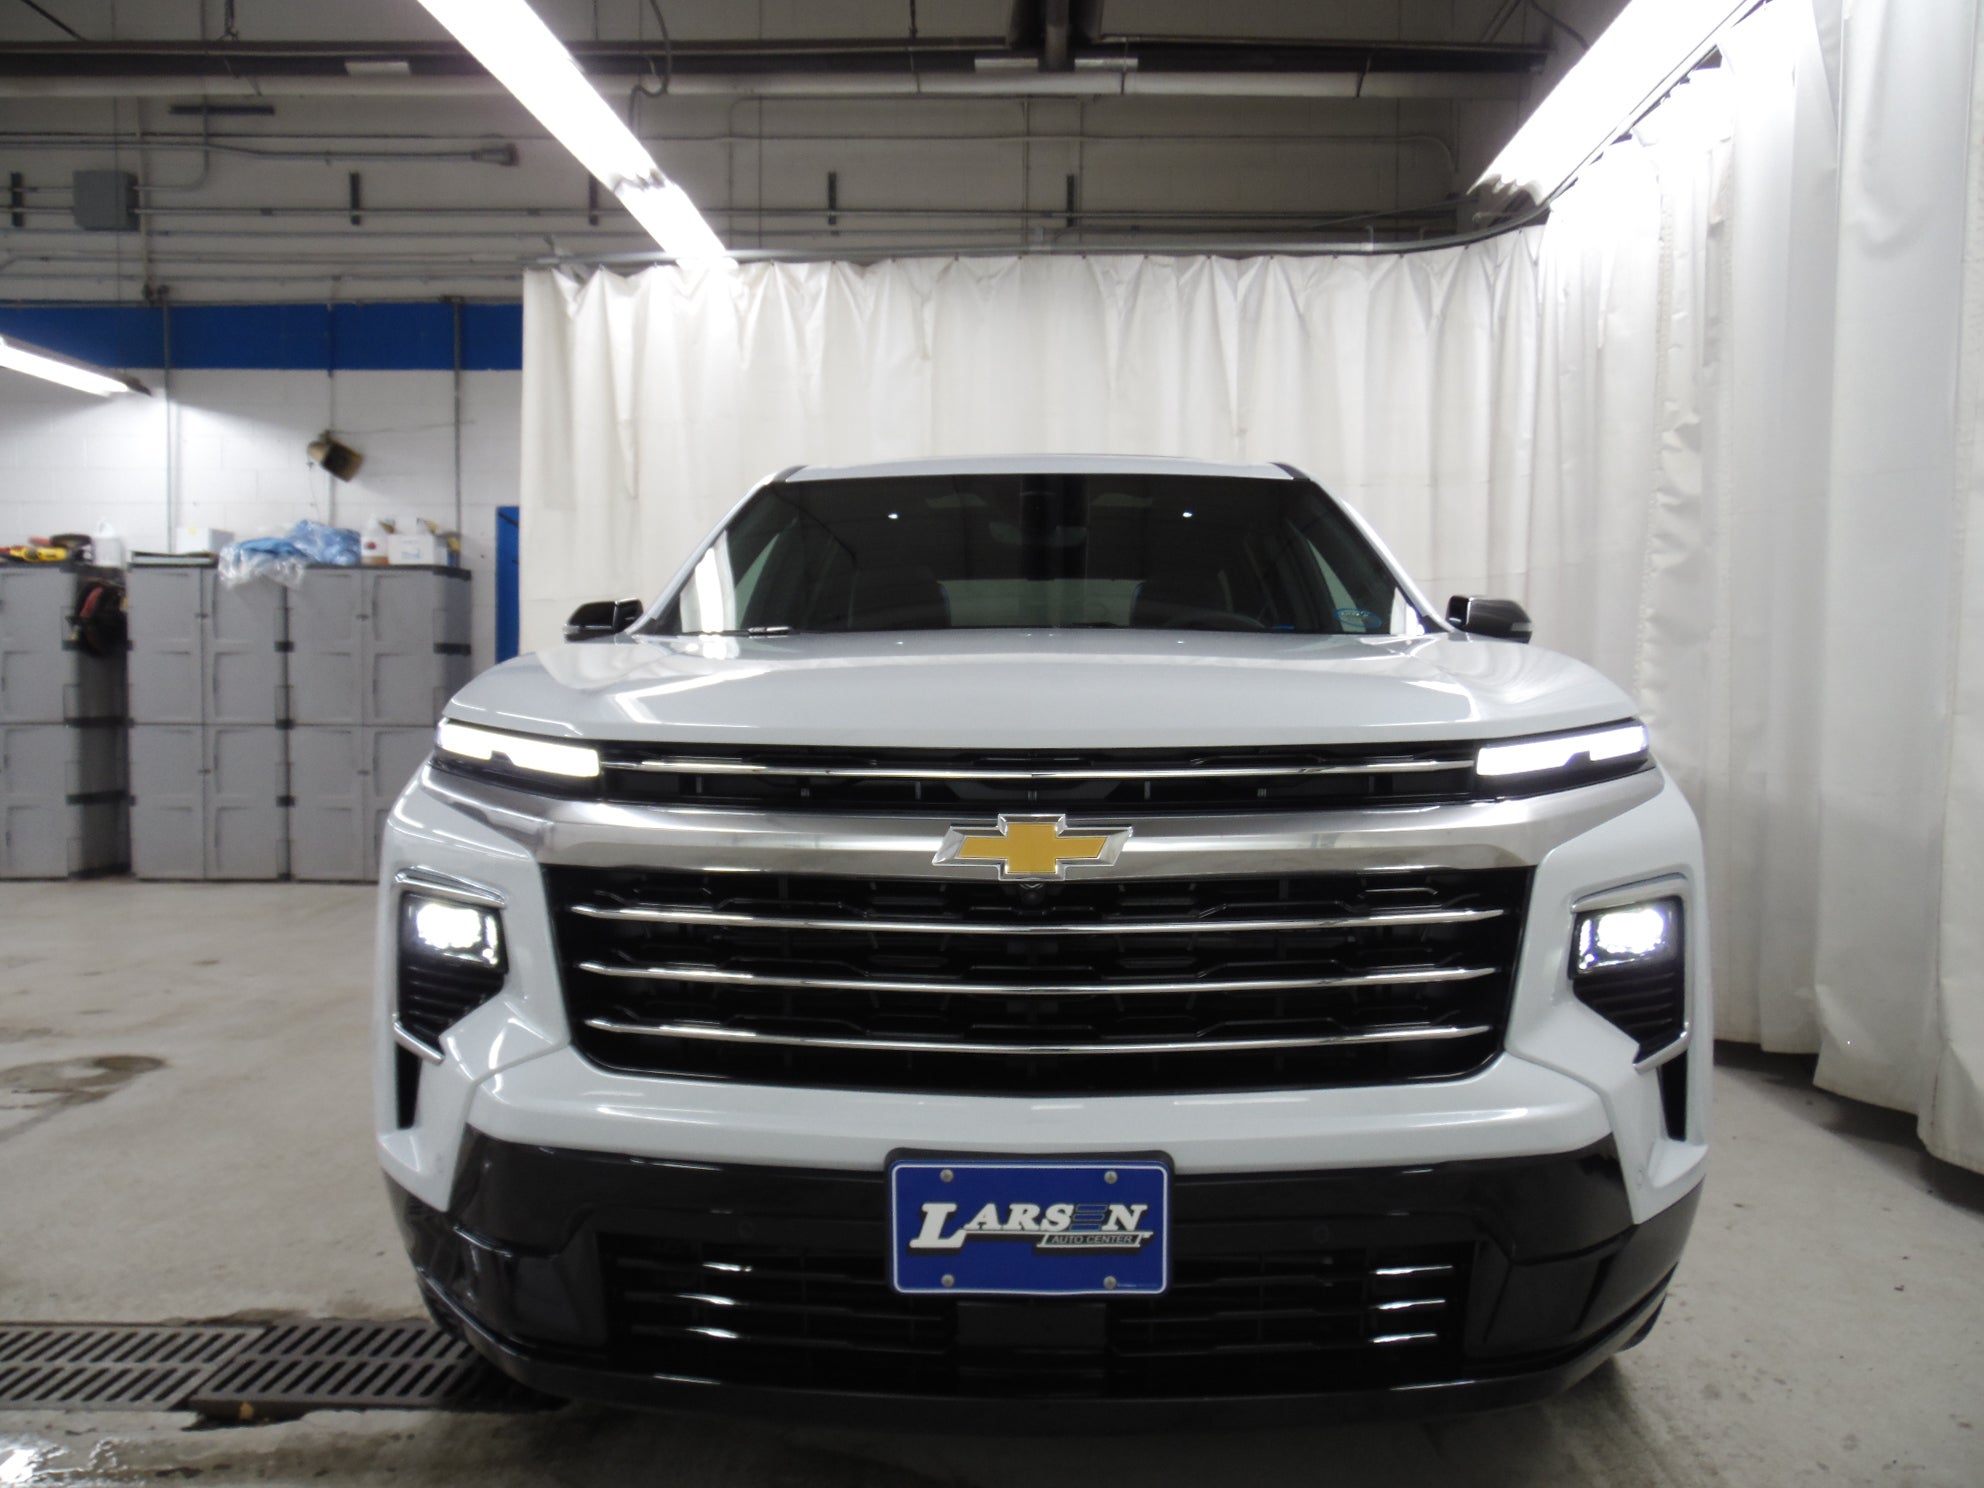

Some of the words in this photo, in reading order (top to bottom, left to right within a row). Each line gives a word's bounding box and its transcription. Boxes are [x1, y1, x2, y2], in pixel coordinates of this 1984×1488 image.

[909, 1203, 1148, 1248] LARSEN
[1051, 1235, 1083, 1244] AUTO
[1086, 1235, 1134, 1244] CENTER
